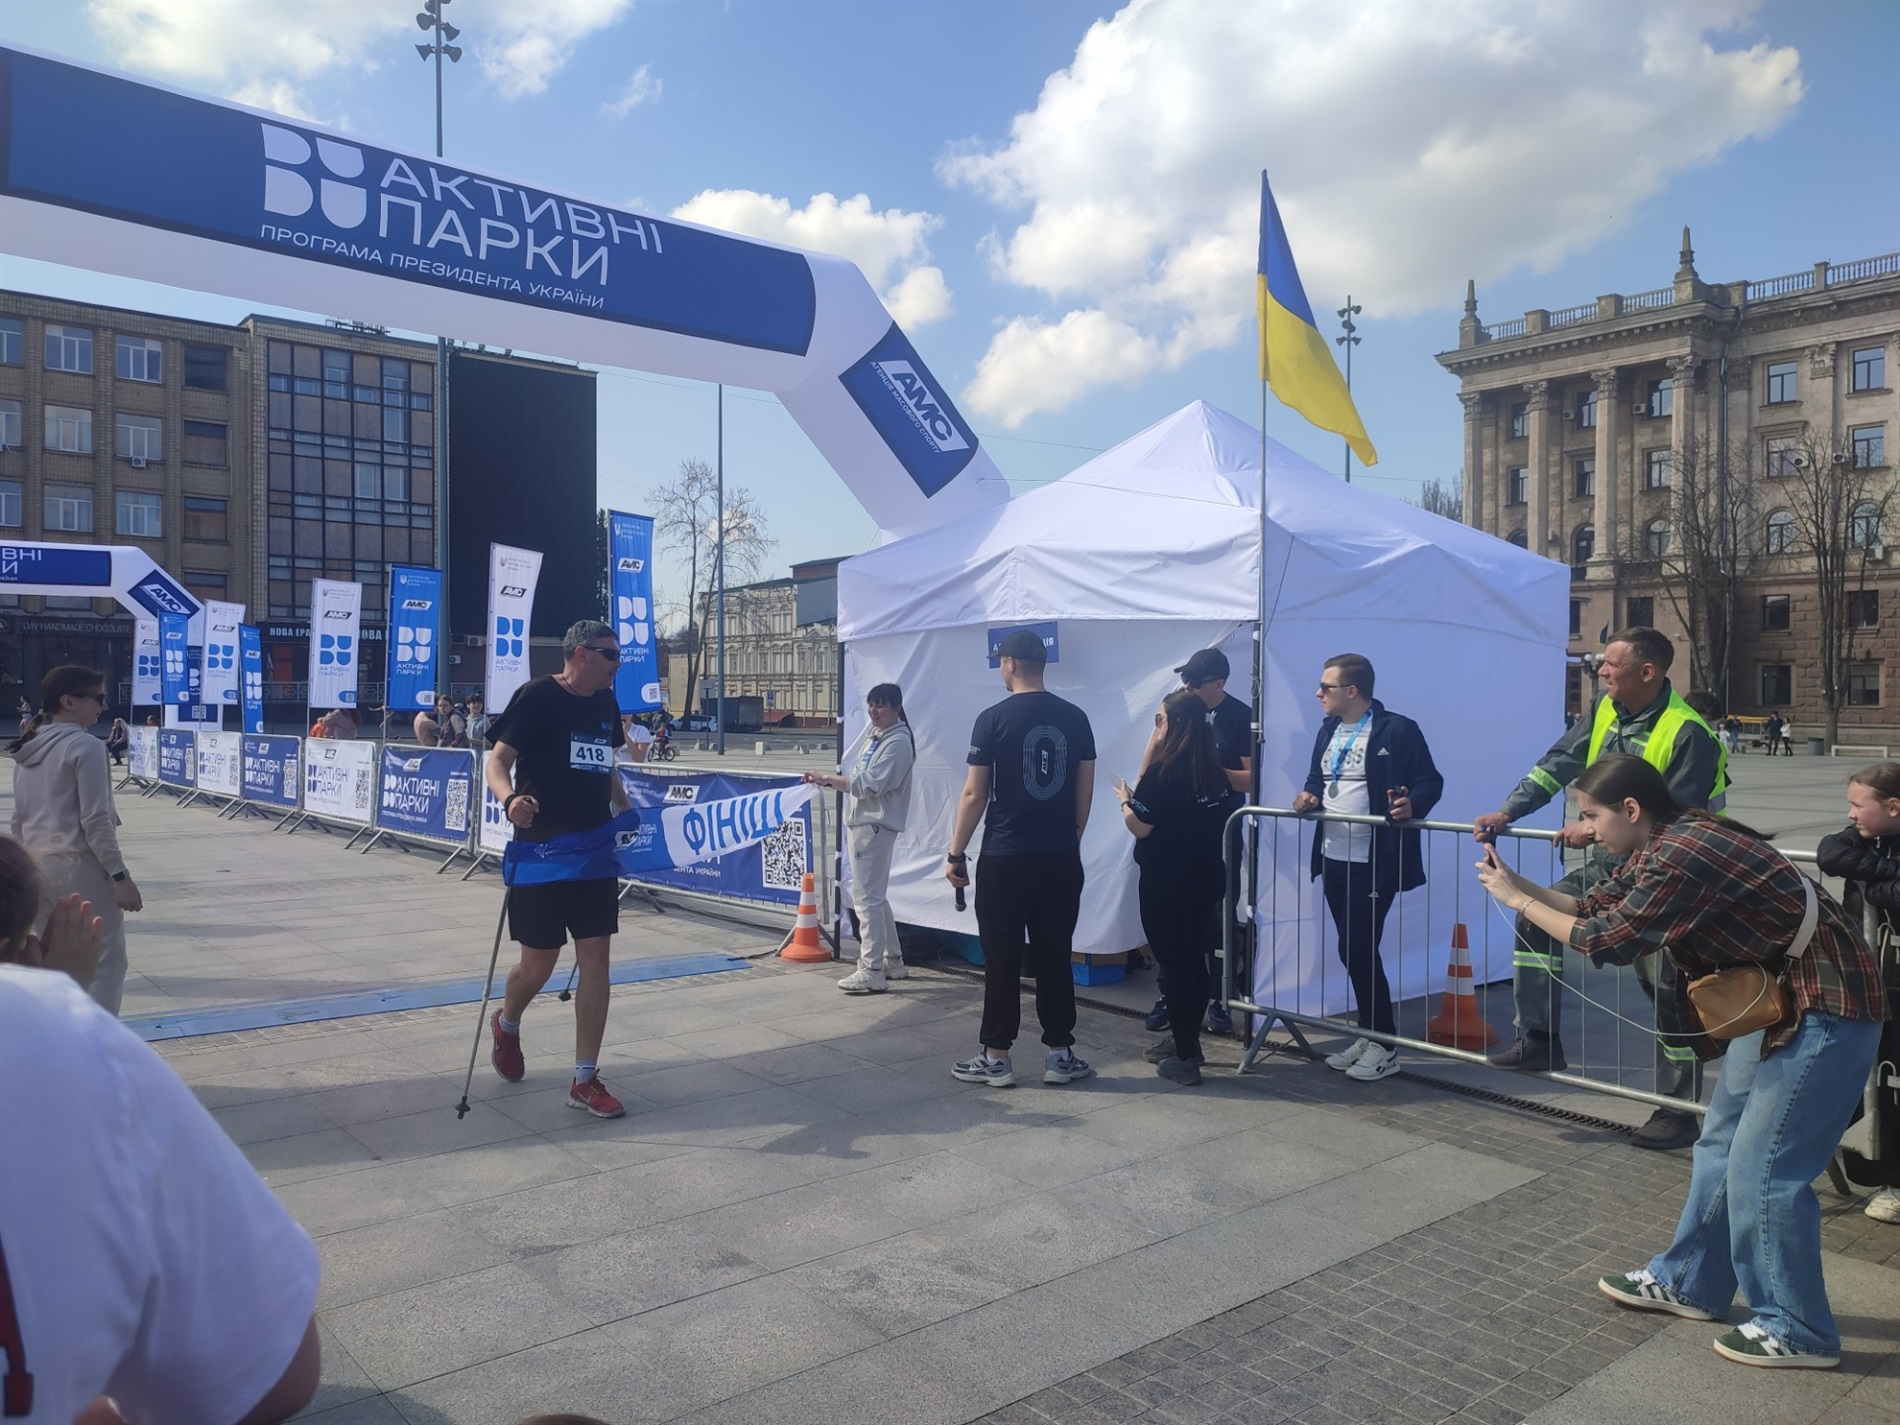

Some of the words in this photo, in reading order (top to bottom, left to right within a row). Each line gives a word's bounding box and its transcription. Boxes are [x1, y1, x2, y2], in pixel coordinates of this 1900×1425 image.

[380, 158, 662, 253] АКТИВНІ
[379, 193, 608, 285] ПАРКИ
[261, 224, 382, 263] ПРОГРАМА
[390, 253, 521, 293] ПРЕЗИДЕНТА
[529, 283, 604, 308] УКРАЇНИ
[870, 361, 894, 391] АГЕНЦІЯ
[891, 389, 921, 429] МАСОВОГО
[919, 427, 941, 453] СПОРТУ
[890, 372, 953, 441] АМС
[23, 621, 39, 632] LVIV
[40, 622, 85, 633] HANDMADE
[85, 623, 131, 634] CHOCOLATE
[270, 627, 294, 637] НОВА
[359, 628, 383, 640] ОВА
[576, 746, 605, 762] 418
[396, 776, 441, 798] АКТИВНІ
[669, 786, 694, 799] АМС
[395, 792, 430, 814] ПАРКИ
[682, 791, 785, 857] ФІНІШ
